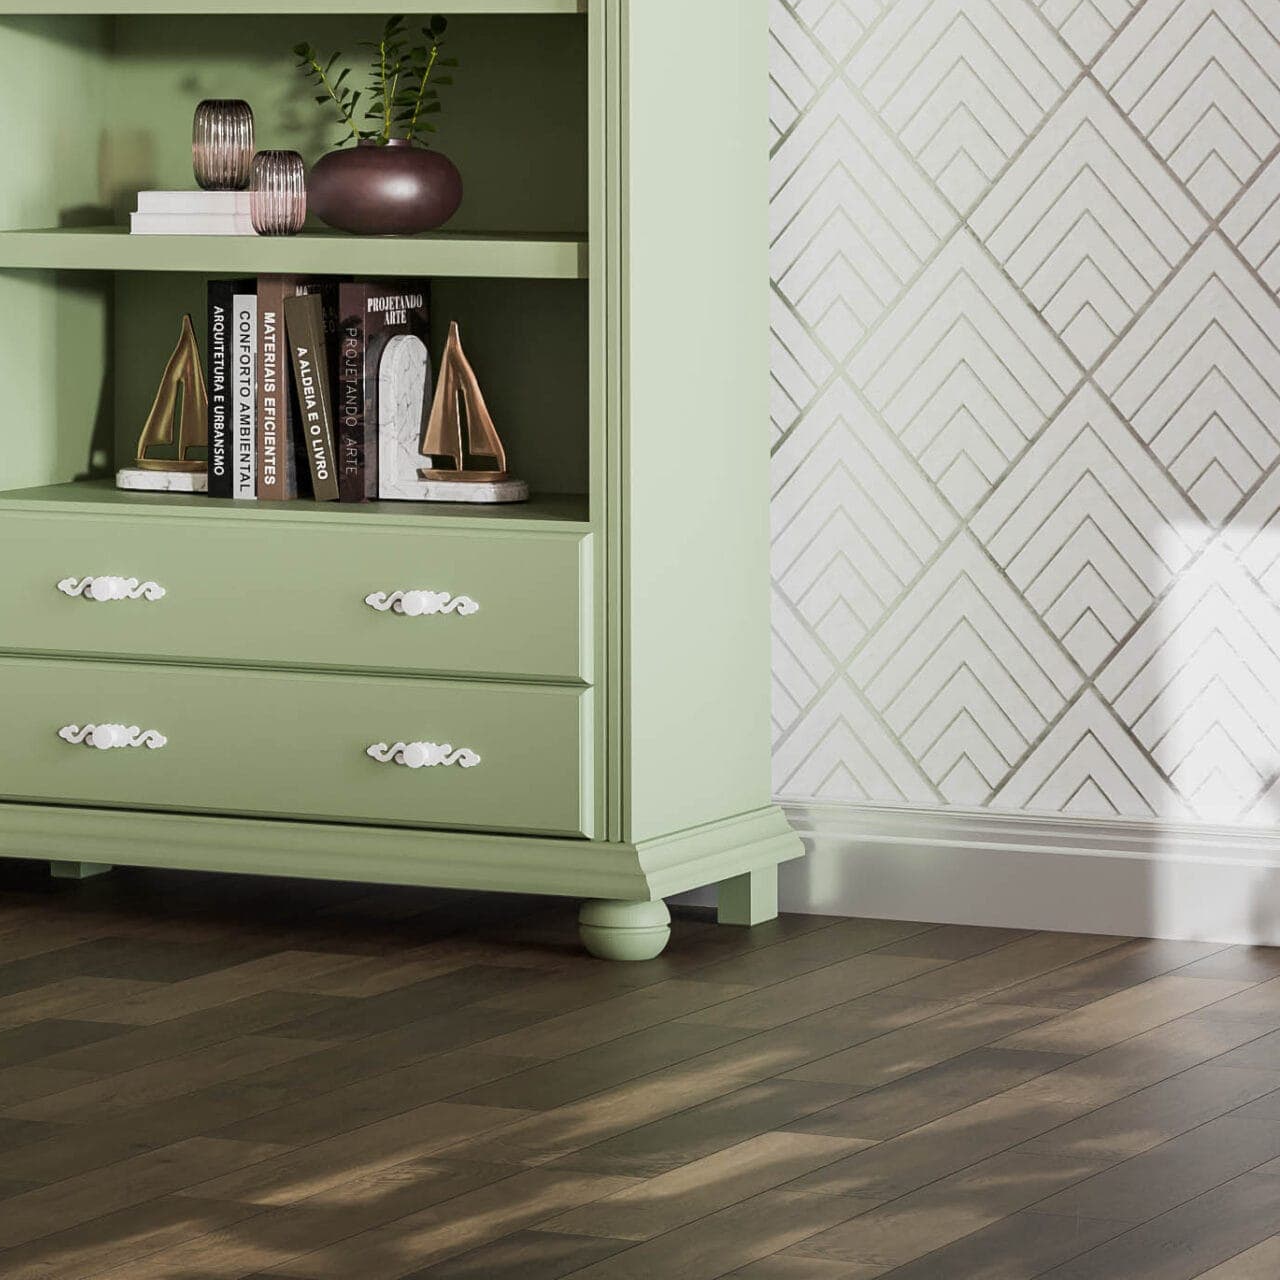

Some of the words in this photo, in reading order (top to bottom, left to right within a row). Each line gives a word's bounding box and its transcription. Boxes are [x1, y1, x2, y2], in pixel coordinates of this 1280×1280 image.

[367, 294, 423, 312] PROJETANDO
[384, 310, 407, 325] ARTE
[213, 305, 225, 392] ARQUITETURA
[239, 310, 251, 398] CONFORTO
[264, 312, 276, 393] MATERIAIS
[297, 347, 308, 358] A
[299, 359, 316, 410] ALDEIA
[345, 327, 358, 427] PROJETANDO
[213, 406, 225, 476] URBANSMO
[264, 398, 276, 486] EFICIENTES
[308, 412, 319, 422] E
[310, 425, 321, 436] O
[239, 403, 251, 492] AMBIENTAL
[312, 439, 329, 480] LIVRO
[345, 437, 358, 475] ARTE
